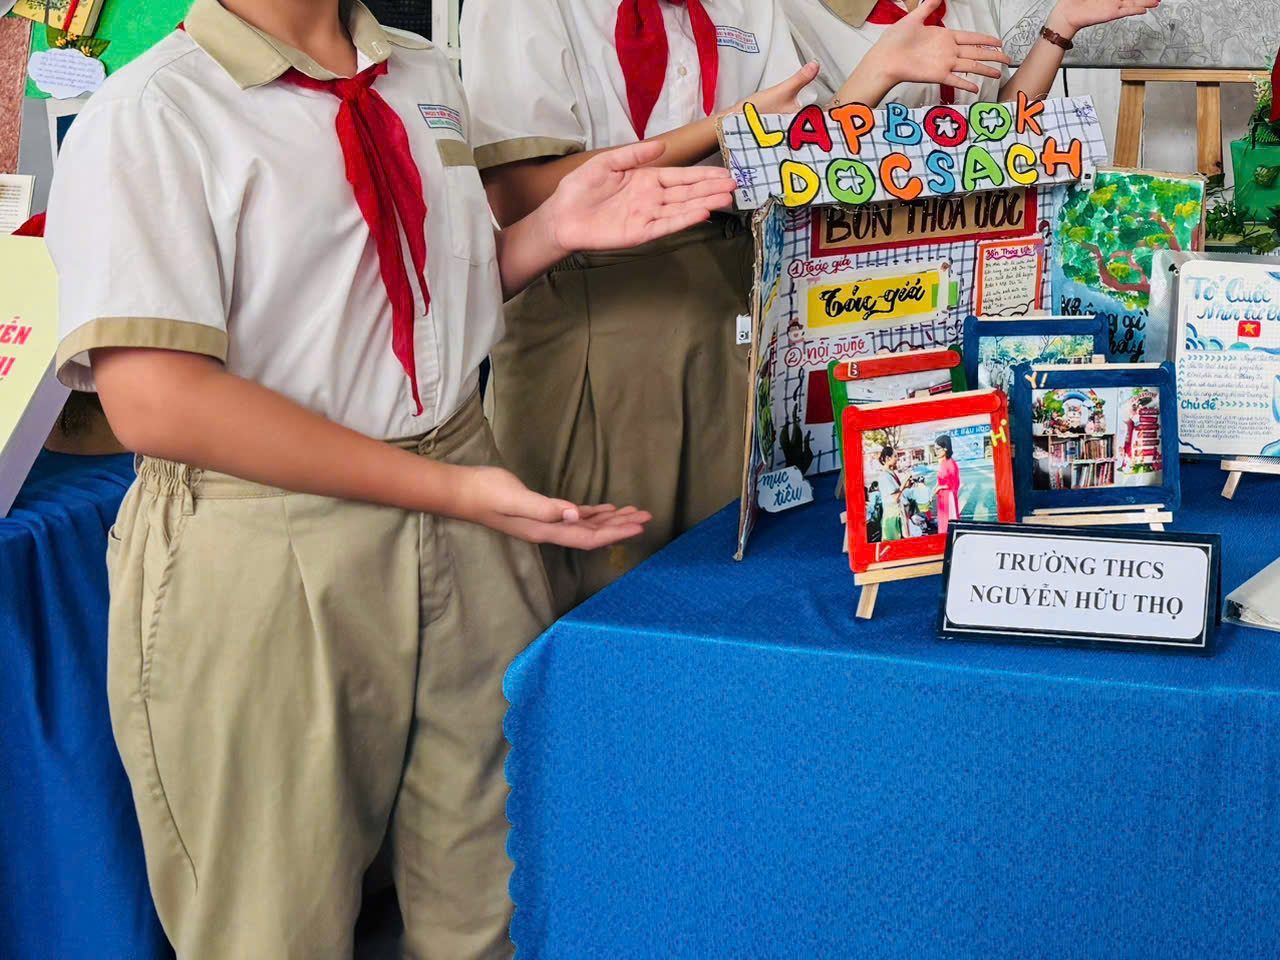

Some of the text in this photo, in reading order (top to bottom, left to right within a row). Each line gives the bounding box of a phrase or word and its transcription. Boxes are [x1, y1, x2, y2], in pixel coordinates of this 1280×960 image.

[743, 90, 1046, 156] LAPBOOK
[773, 483, 803, 506] tiêu
[995, 550, 1165, 580] TRƯỜNG THCS
[969, 583, 1184, 620] NGUYỄN HỮU THỌ
